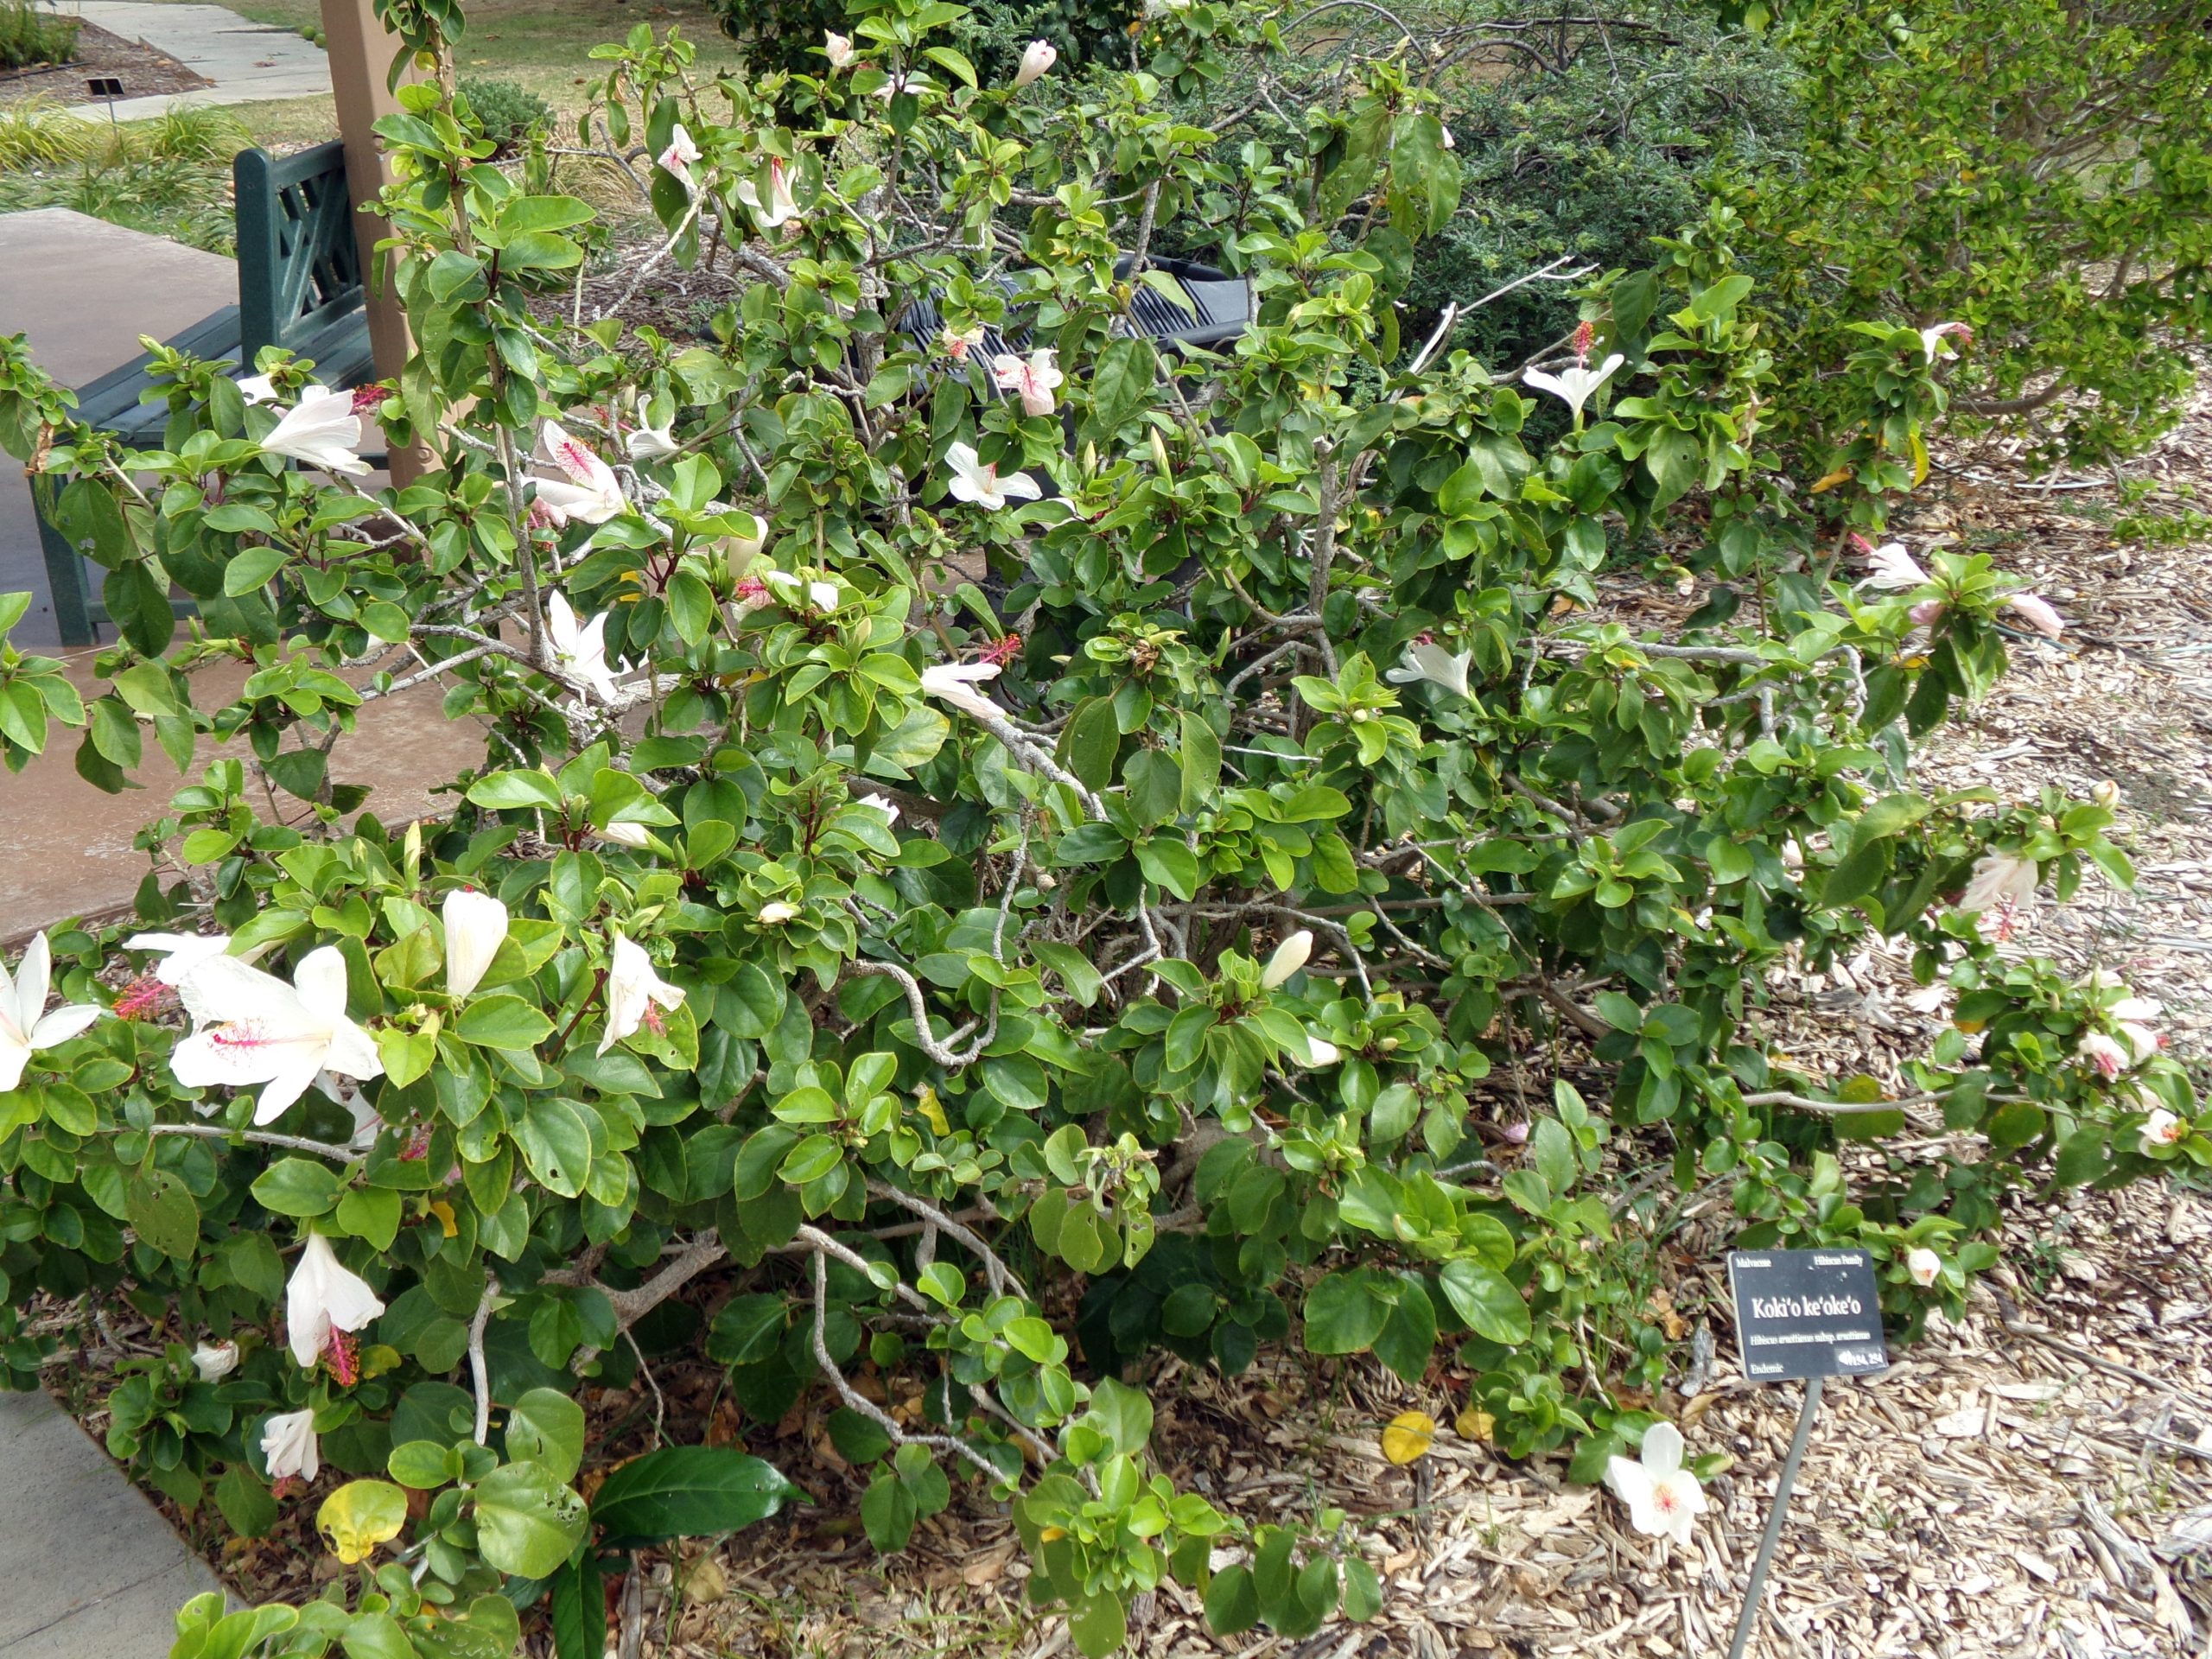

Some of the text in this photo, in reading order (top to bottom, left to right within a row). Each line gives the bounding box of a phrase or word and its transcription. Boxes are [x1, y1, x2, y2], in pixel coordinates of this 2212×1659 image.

[1814, 1255, 1864, 1268] Hibiscus Family
[1750, 1335, 1777, 1346] Hibiscus
[1750, 1363, 1784, 1375] Endemic
